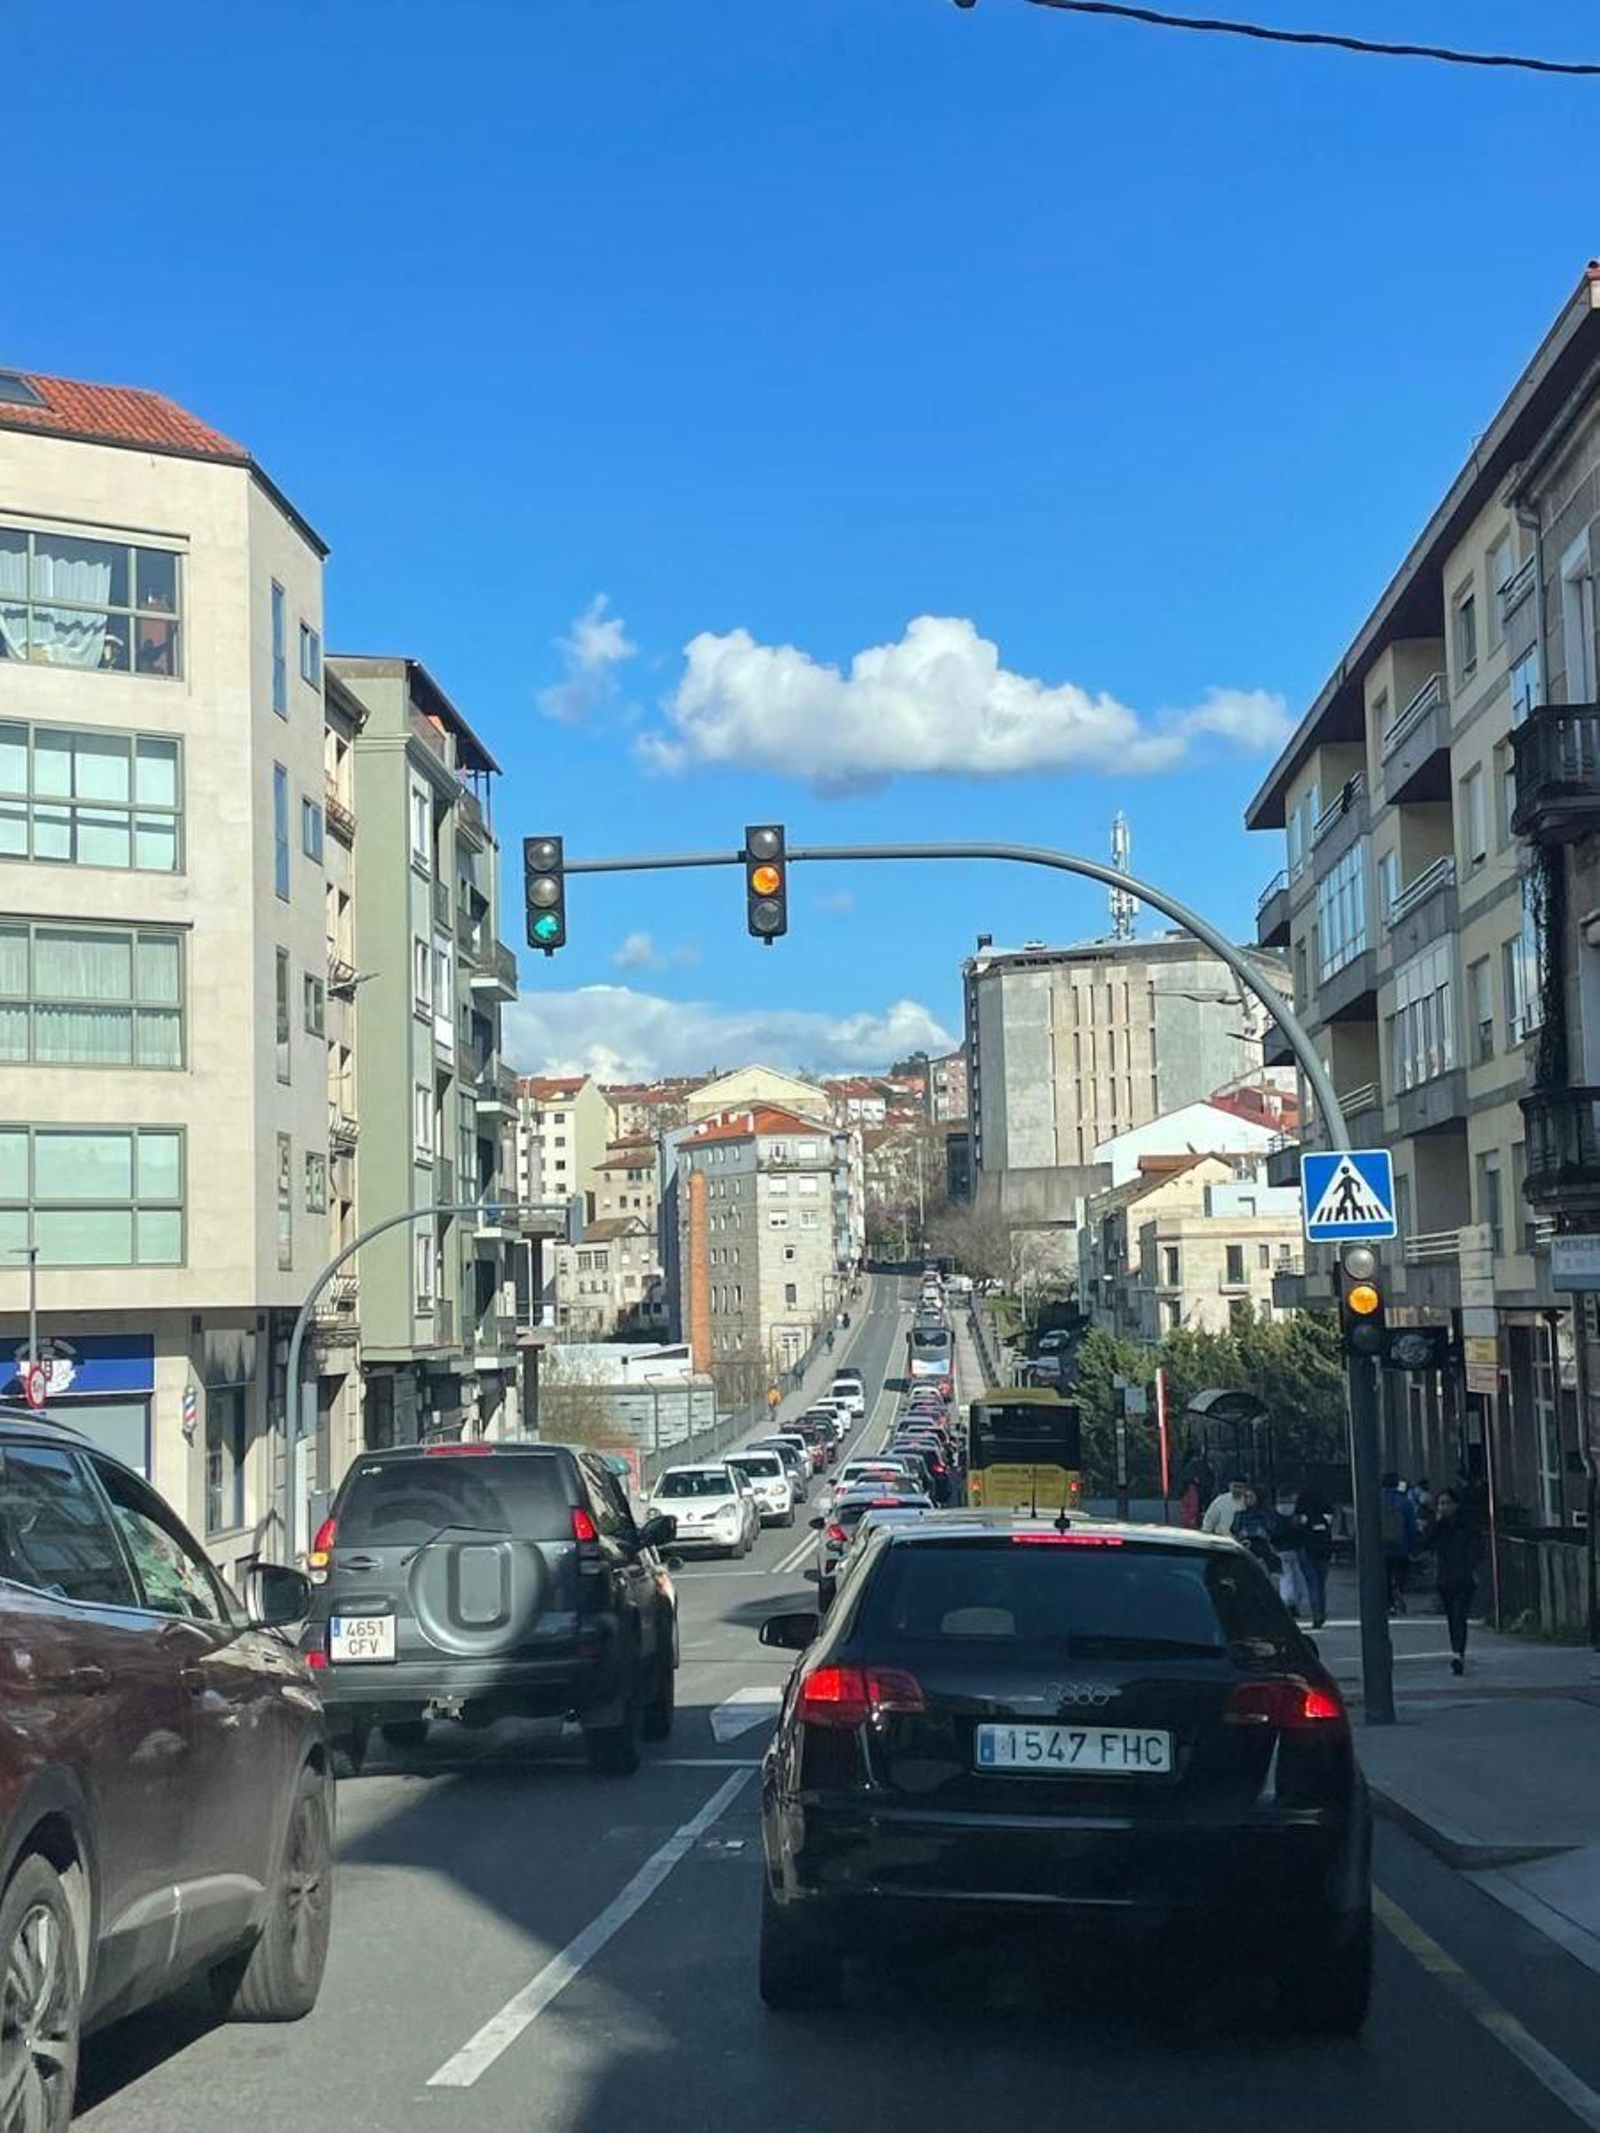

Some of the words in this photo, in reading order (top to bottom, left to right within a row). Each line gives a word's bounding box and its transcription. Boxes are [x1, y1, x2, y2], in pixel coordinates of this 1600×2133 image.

[346, 1620, 384, 1636] 4651
[349, 1638, 378, 1655] CFV
[1007, 1730, 1087, 1763] 1547
[1101, 1734, 1164, 1766] FHC
